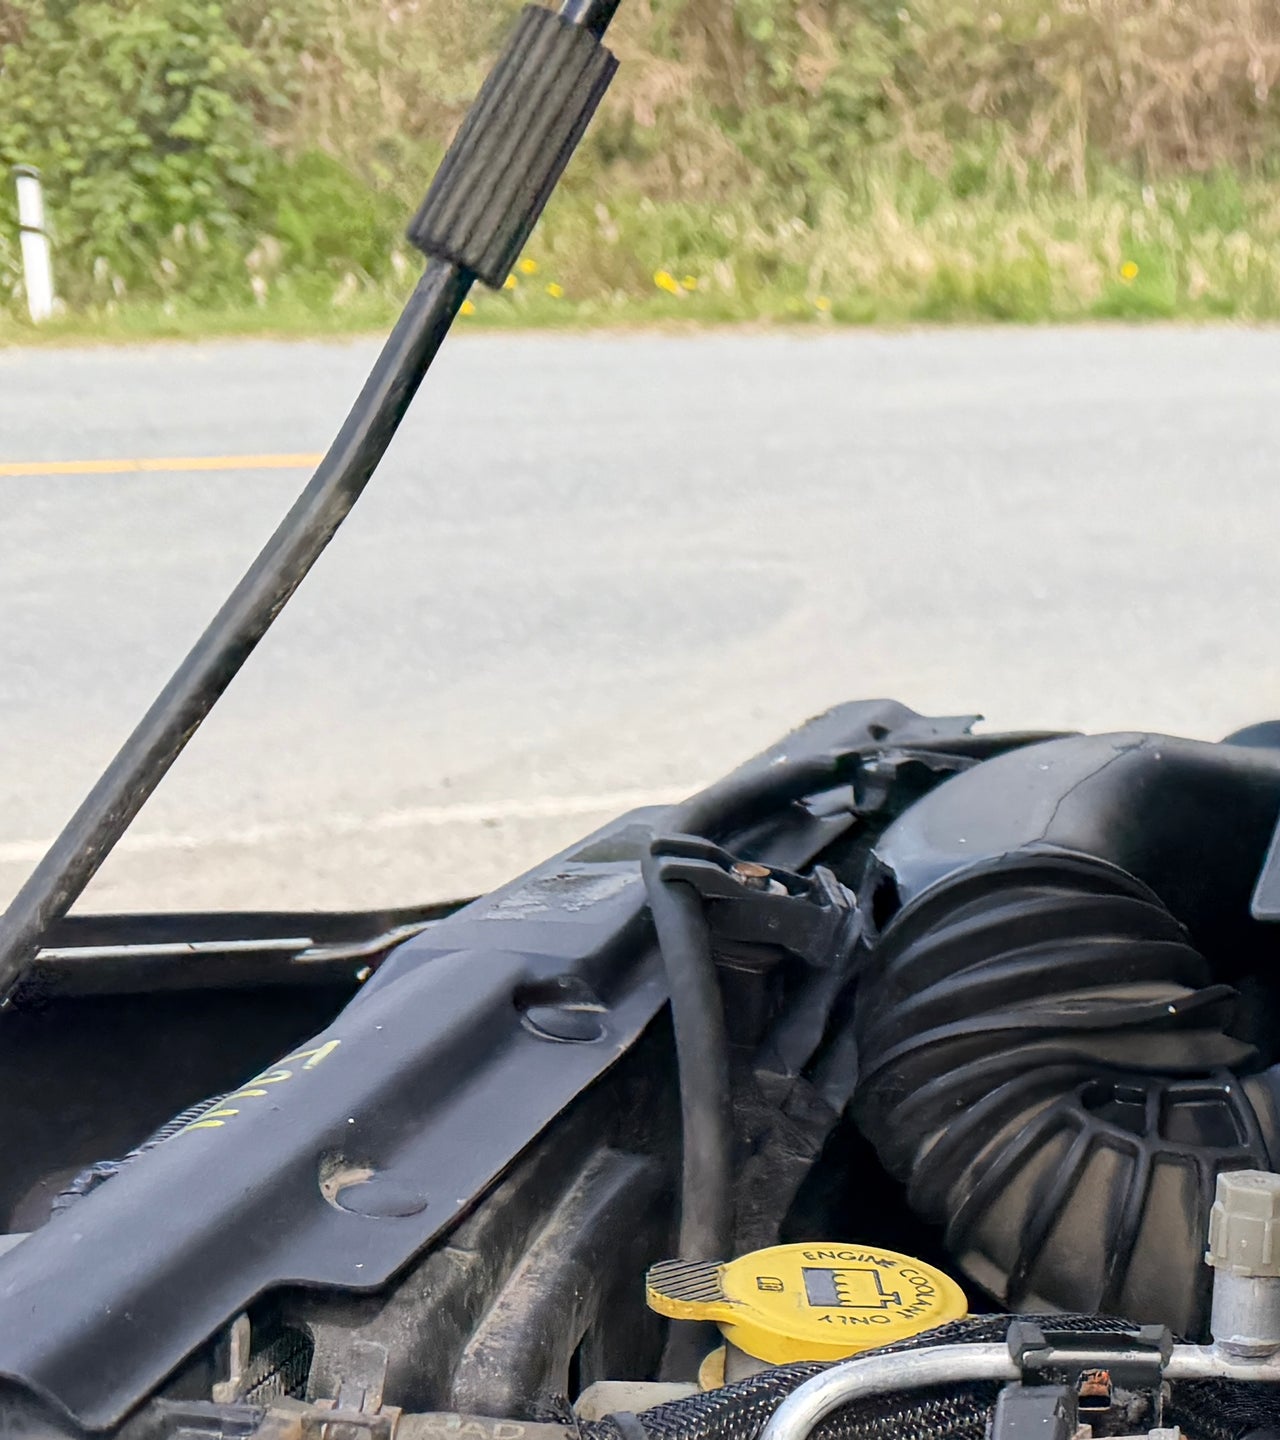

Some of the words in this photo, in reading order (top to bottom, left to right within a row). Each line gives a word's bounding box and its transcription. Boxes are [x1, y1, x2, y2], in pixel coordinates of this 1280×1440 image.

[803, 1251, 897, 1269] ENGINE
[896, 1269, 936, 1320] COOLANT
[818, 1314, 891, 1325] ONLY
